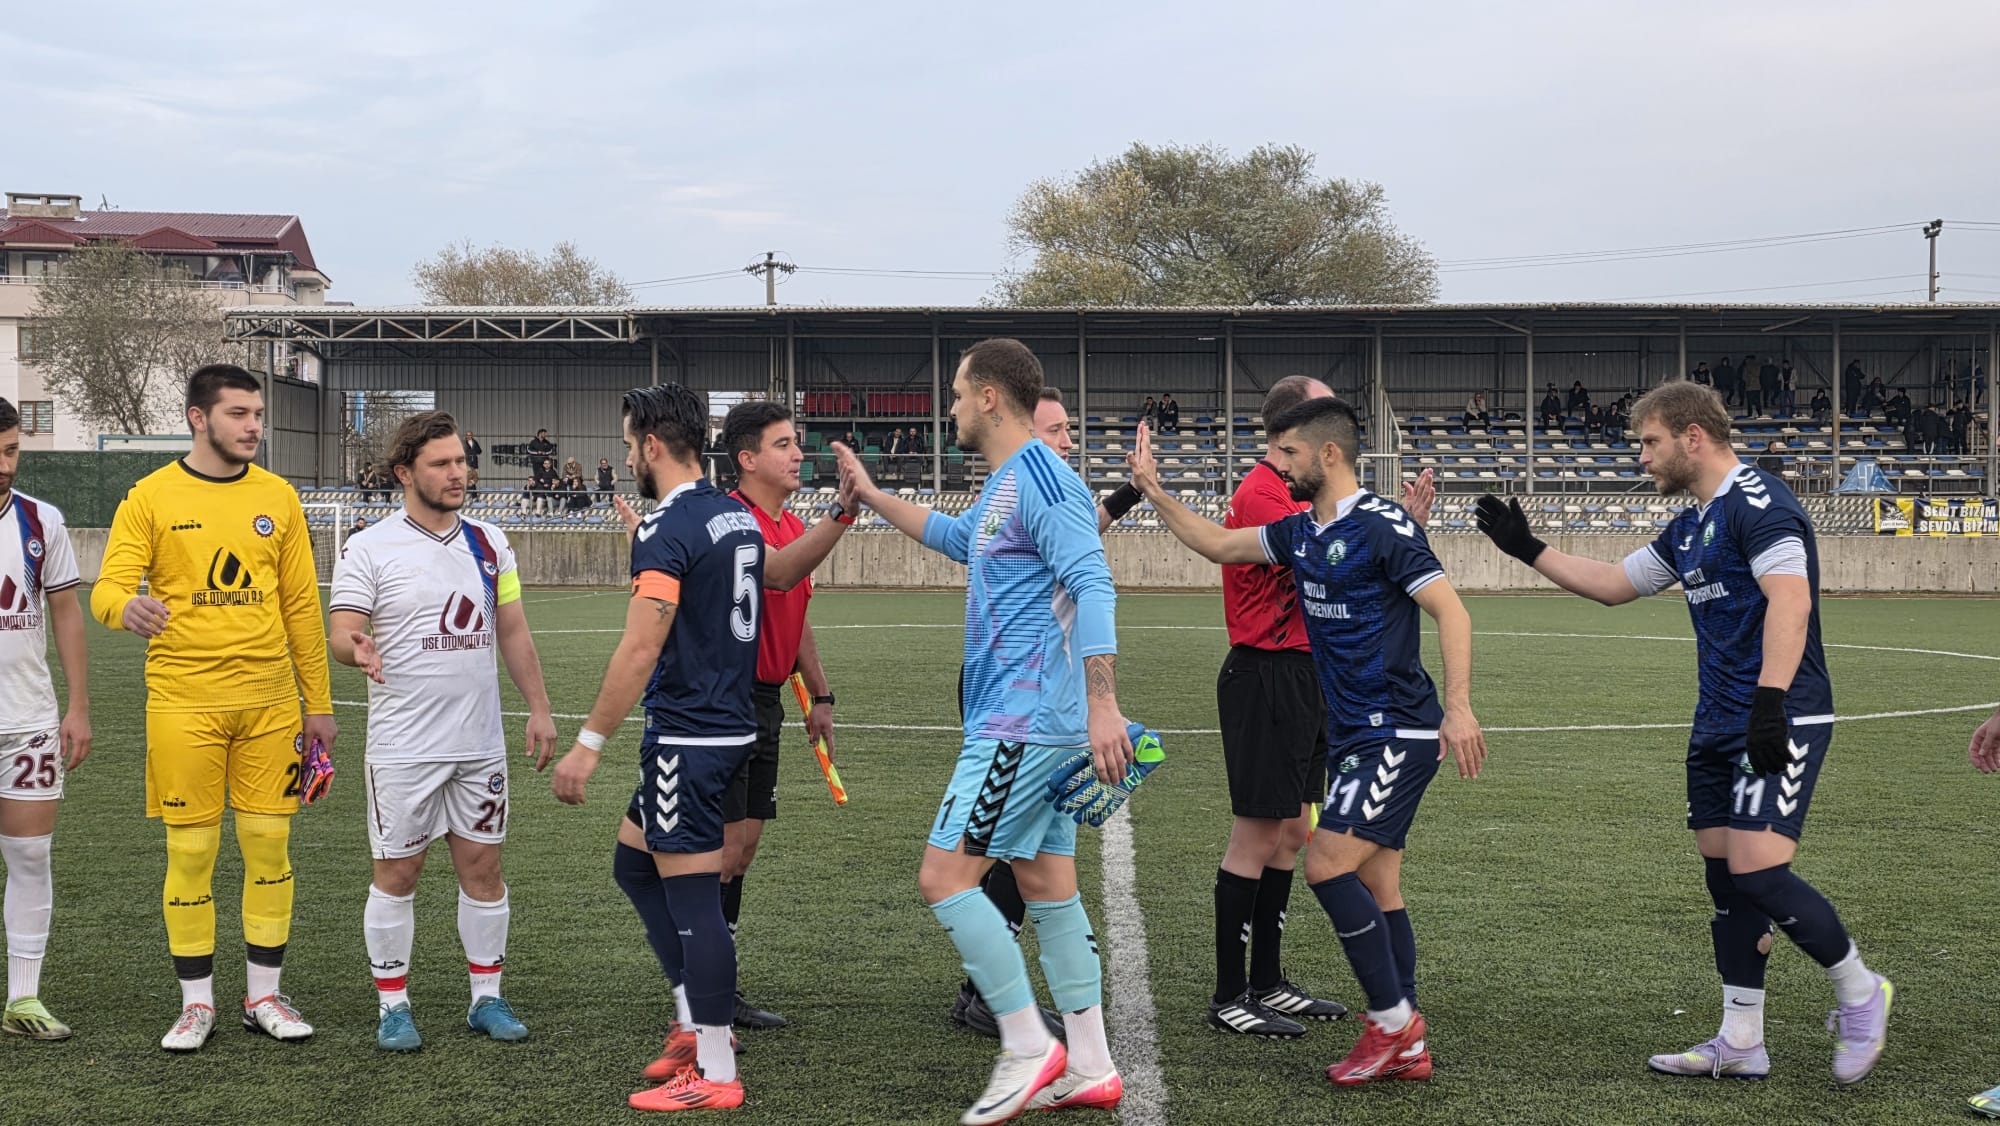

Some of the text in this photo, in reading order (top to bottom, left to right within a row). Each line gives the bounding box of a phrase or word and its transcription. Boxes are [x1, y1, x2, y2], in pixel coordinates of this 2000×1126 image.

[1920, 520, 1960, 533] SEVDA
[1923, 505, 1958, 518] SEMT
[730, 544, 759, 642] 5
[422, 636, 439, 650] USE
[12, 752, 56, 789] 25
[939, 794, 957, 831] 1
[1732, 775, 1766, 817] 11
[472, 798, 507, 834] 21
